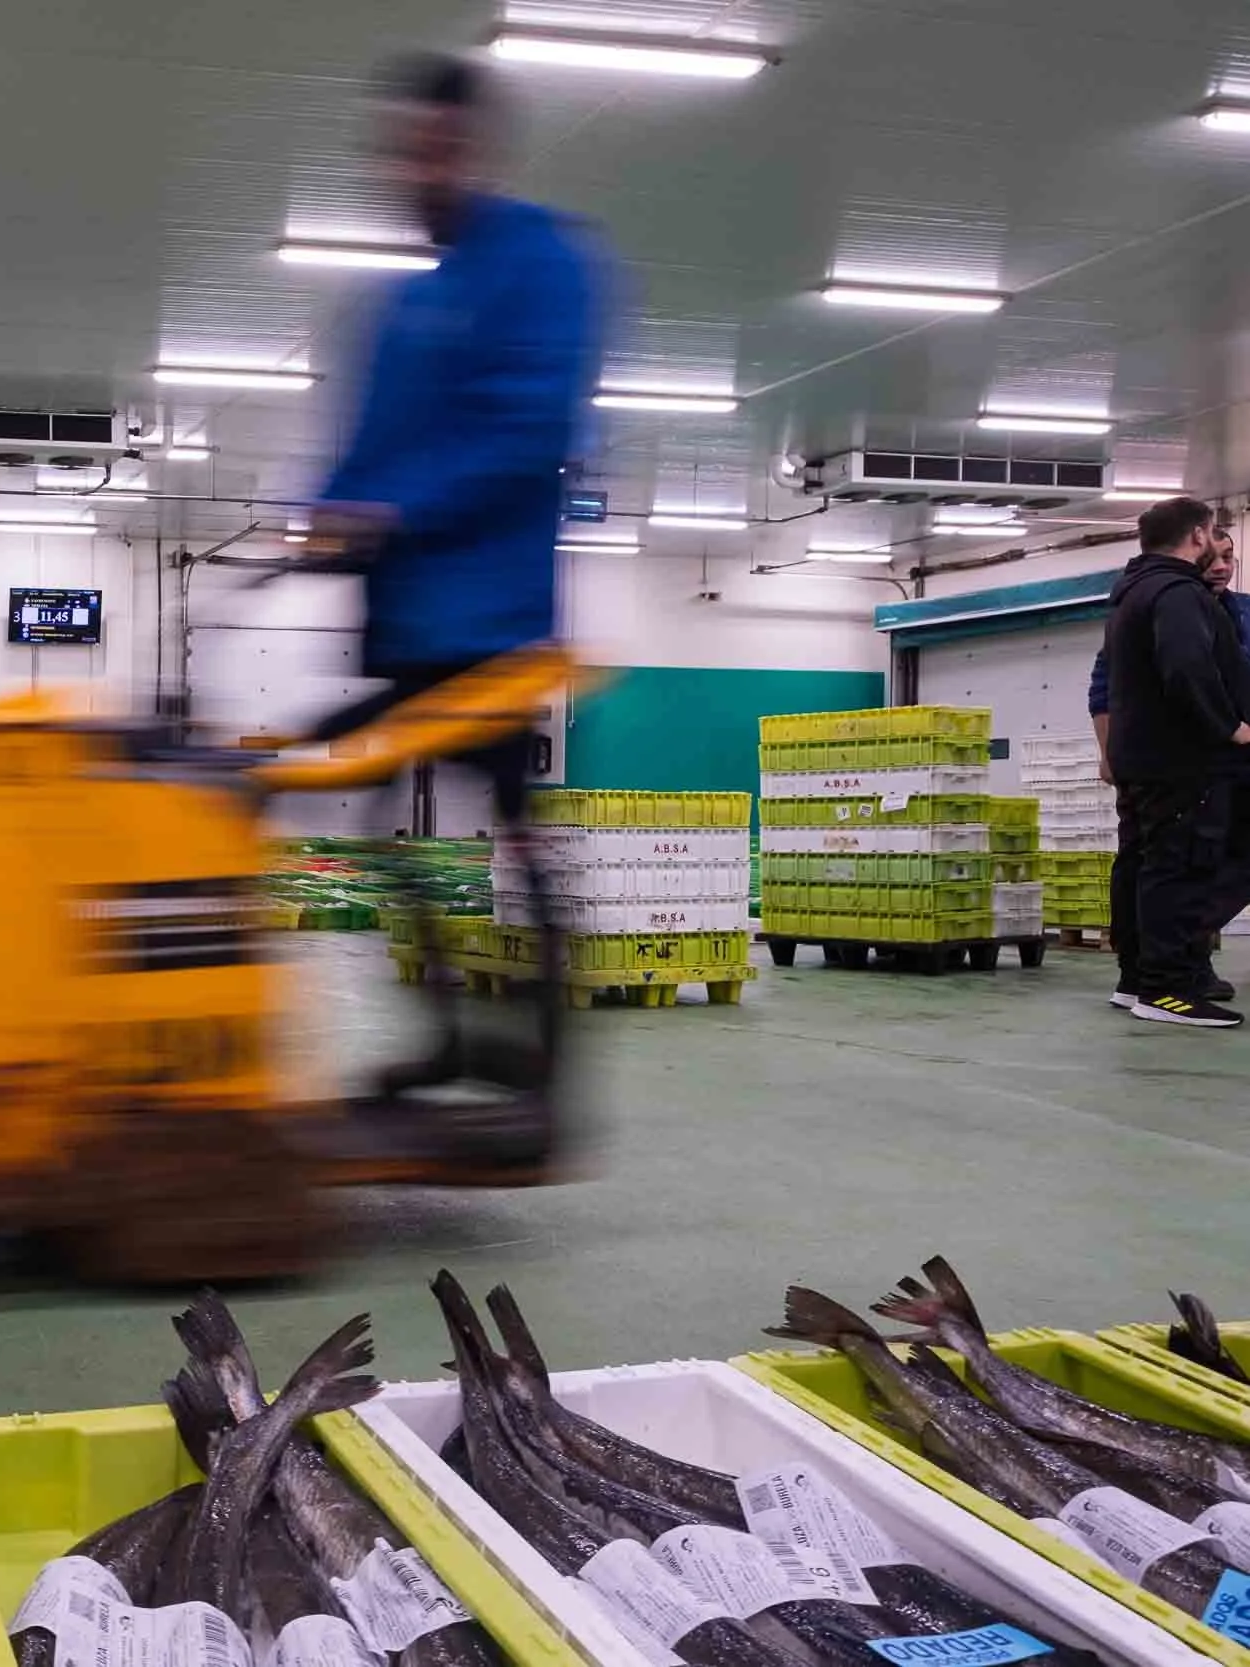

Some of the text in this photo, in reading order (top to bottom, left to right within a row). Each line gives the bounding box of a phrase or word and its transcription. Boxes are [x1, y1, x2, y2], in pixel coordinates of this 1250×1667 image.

[13, 611, 69, 623] 3 11,45
[654, 843, 688, 853] A.B.S.A
[772, 1475, 793, 1509] BURELA
[881, 1630, 1013, 1660] REDADO
